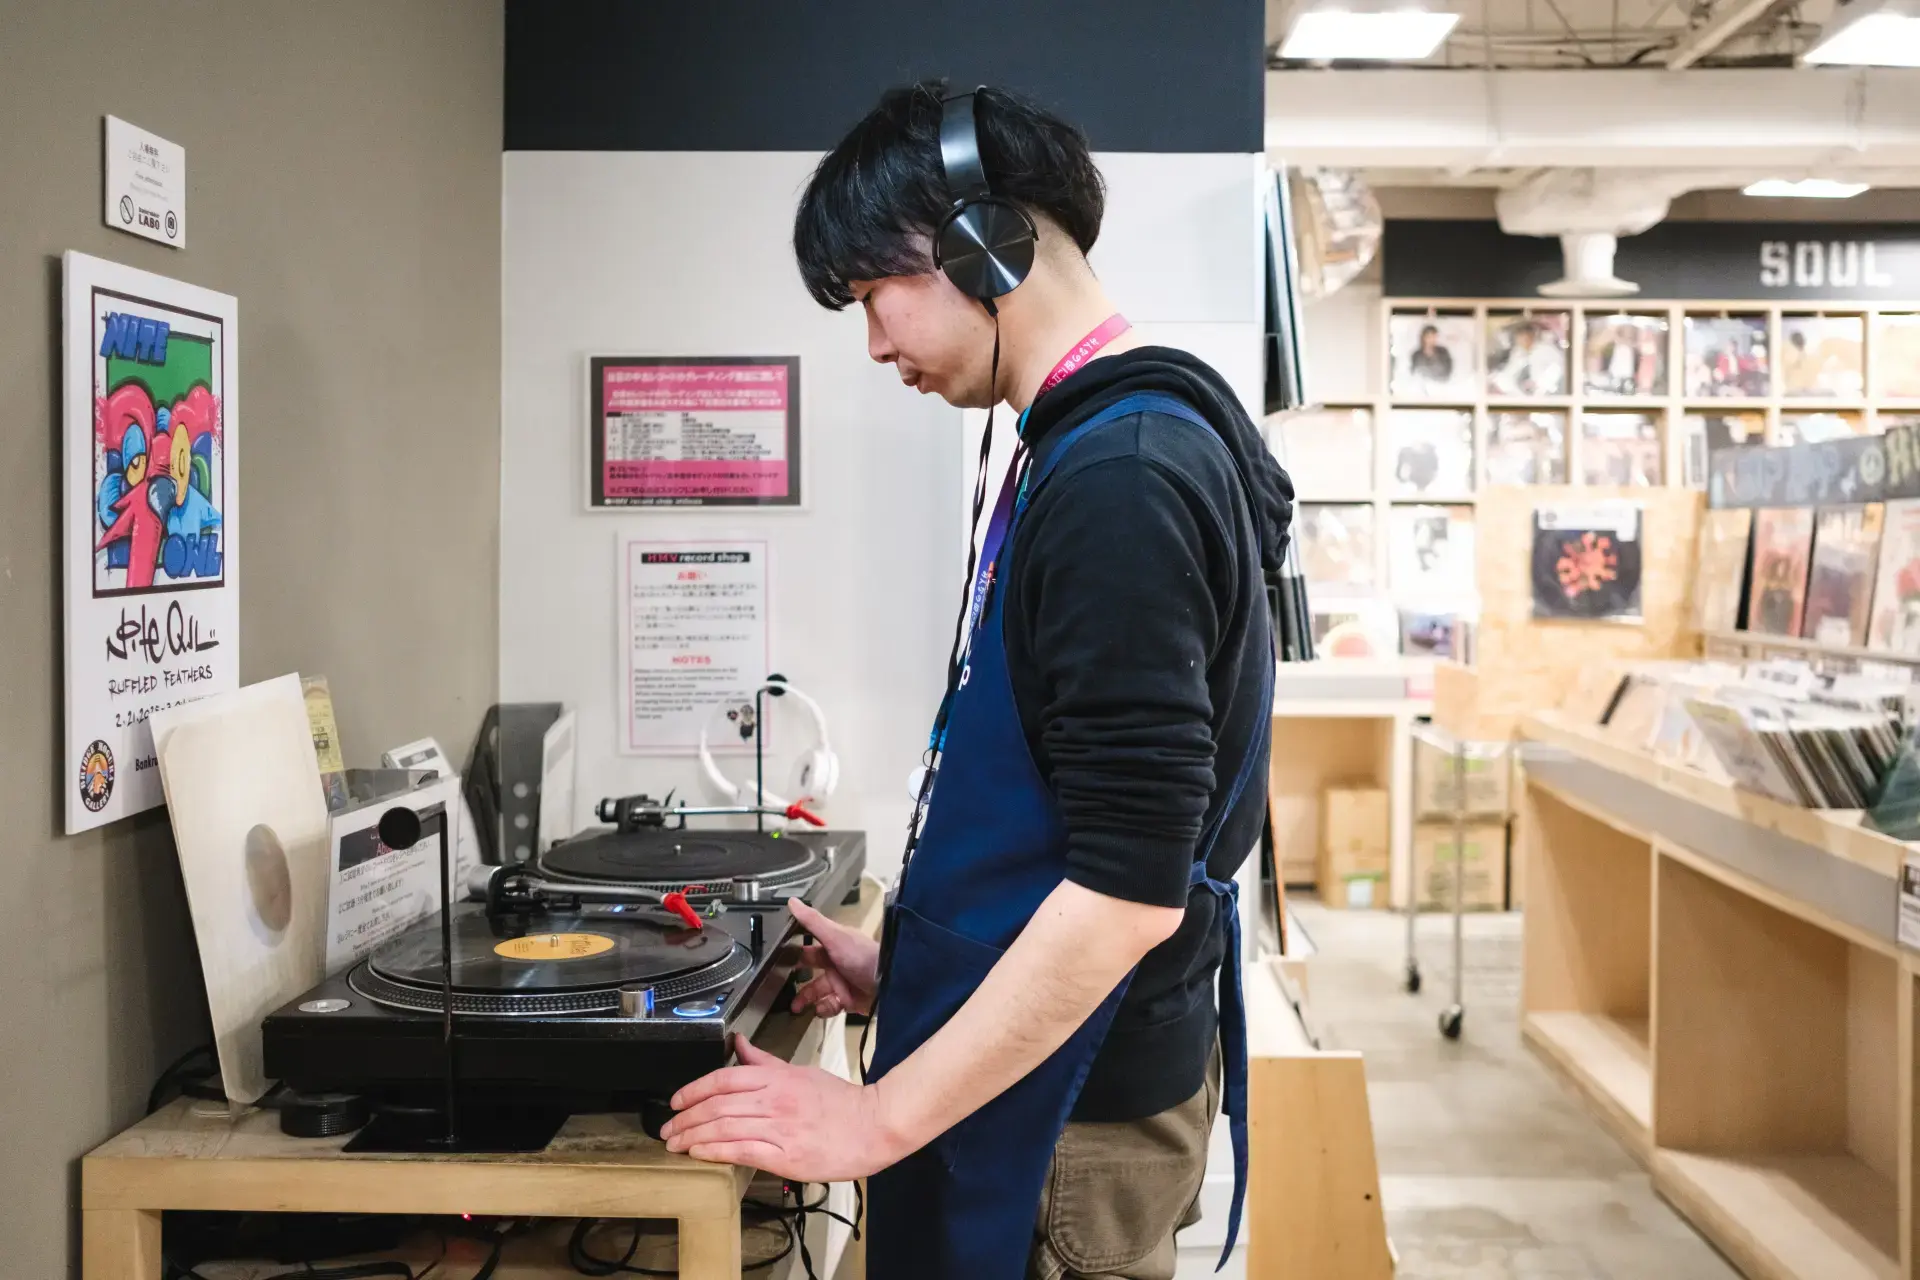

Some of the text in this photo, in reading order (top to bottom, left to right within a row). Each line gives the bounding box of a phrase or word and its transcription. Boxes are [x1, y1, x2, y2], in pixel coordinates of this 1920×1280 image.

[138, 214, 160, 231] LABO
[1760, 240, 1893, 287] SOUL
[100, 312, 170, 366] NITE
[163, 532, 222, 579] OWL
[648, 553, 744, 563] HMV record shop
[671, 655, 712, 665] NOTES
[108, 664, 213, 701] RUFFLED FEATHERS
[85, 790, 110, 810] GALLERY
